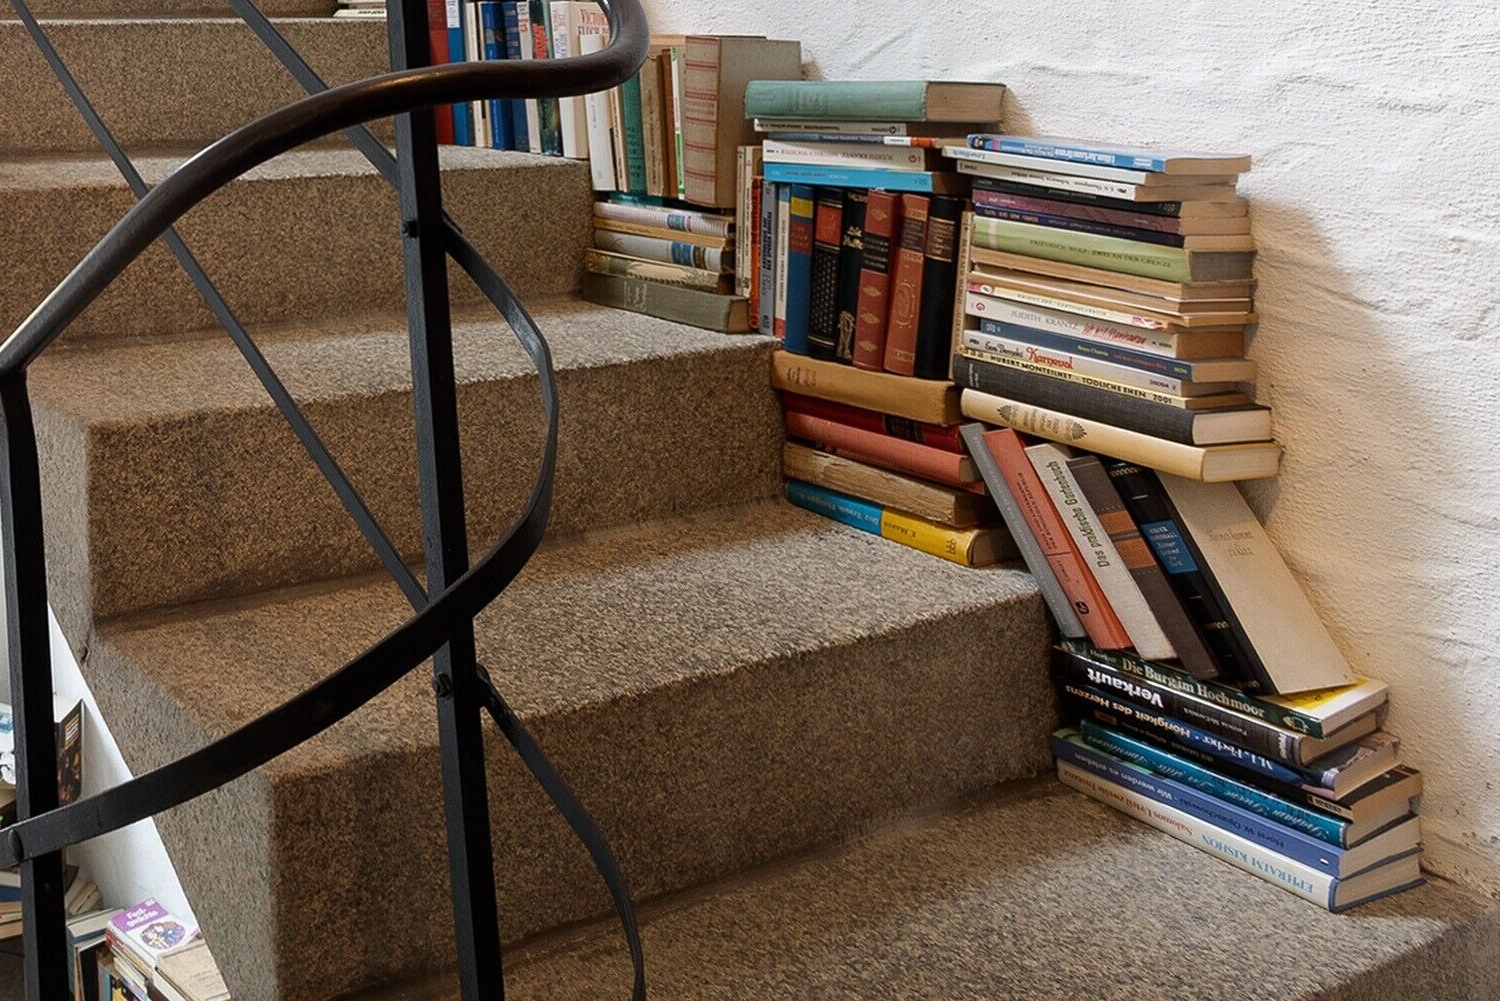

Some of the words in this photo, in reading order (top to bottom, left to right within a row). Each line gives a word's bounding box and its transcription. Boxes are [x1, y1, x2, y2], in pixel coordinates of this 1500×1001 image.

[1010, 308, 1041, 324] JUDITH
[1044, 315, 1080, 332] KRANTZ
[990, 353, 1021, 369] HUBERT
[1026, 346, 1074, 370] Karneval
[1045, 460, 1078, 506] Gartenbuch
[1072, 507, 1104, 549] praktische
[1094, 549, 1111, 568] Das
[1065, 684, 1110, 709] Herzens
[1086, 667, 1165, 709] Verkauft
[1121, 656, 1144, 676] Die
[1144, 665, 1175, 691] Burg
[1174, 677, 1195, 693] im
[1196, 682, 1266, 719] Hochmoor
[1112, 701, 1134, 716] des
[1201, 734, 1244, 760] Fischer
[1074, 751, 1107, 772] erleben
[1108, 767, 1120, 777] es
[1157, 762, 1187, 778] stille
[1063, 769, 1098, 793] Instanz
[1120, 772, 1156, 794] werden
[1187, 775, 1215, 795] Der
[1096, 784, 1127, 805] zweite
[1156, 787, 1174, 801] Wir
[1225, 789, 1271, 817] Greene
[1125, 796, 1152, 818] Urteil
[1150, 810, 1194, 837] Salomos
[1243, 823, 1256, 836] W.
[1271, 808, 1331, 842] Graham
[1201, 833, 1249, 865] KISHON
[1257, 831, 1285, 849] Horst
[1250, 856, 1315, 896] EPHRAIM
